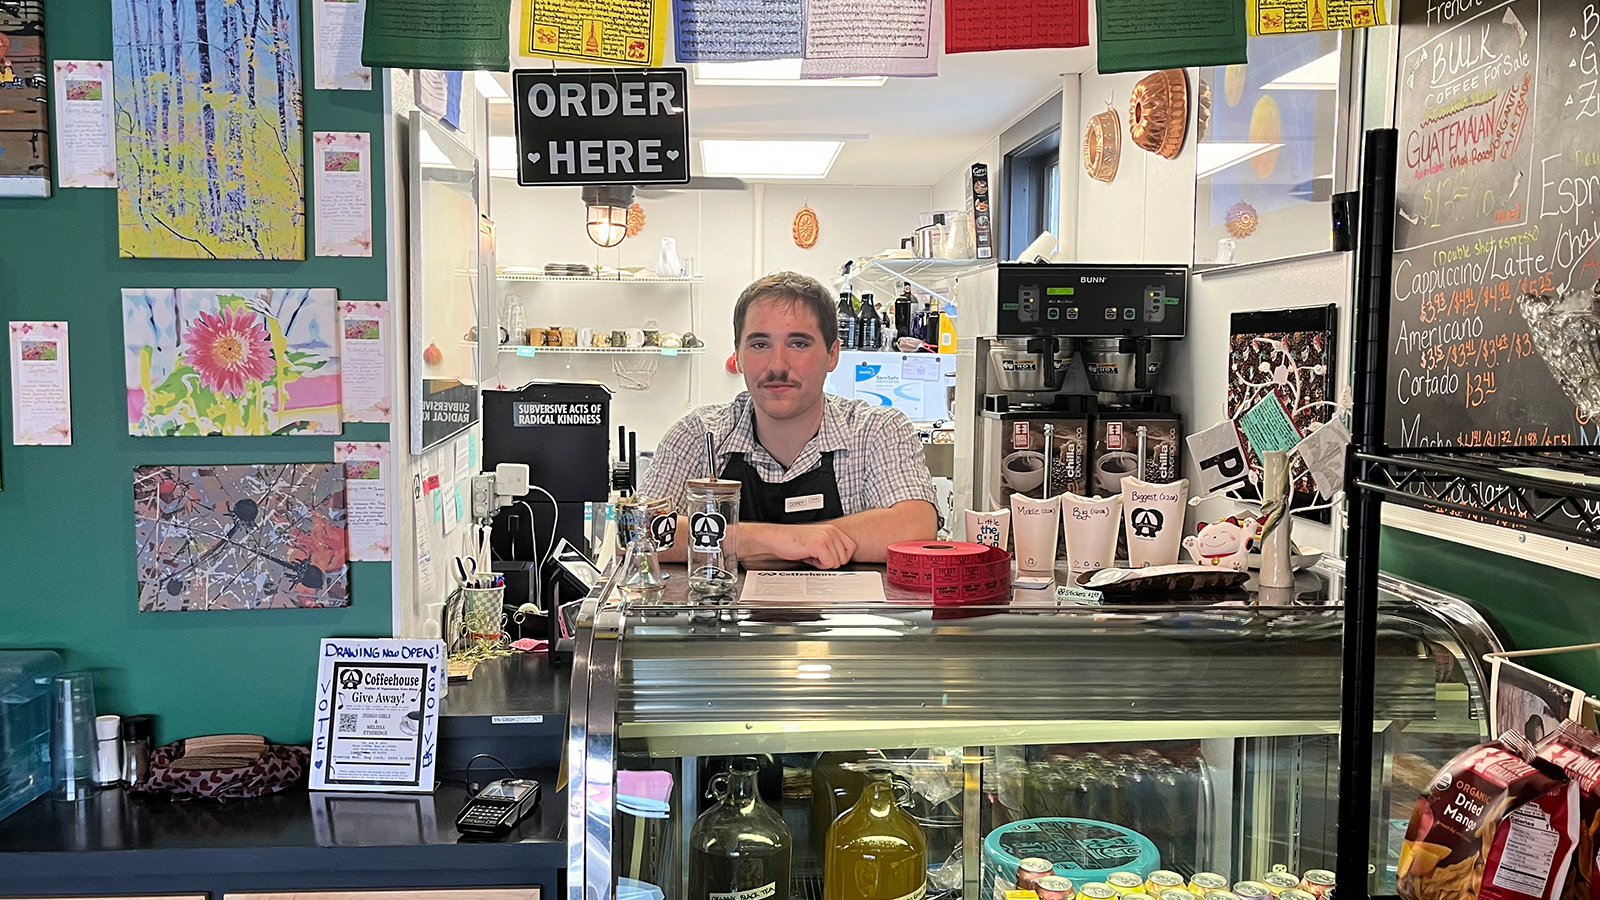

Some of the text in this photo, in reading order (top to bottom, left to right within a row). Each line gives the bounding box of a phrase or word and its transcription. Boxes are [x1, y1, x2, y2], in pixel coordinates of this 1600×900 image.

[1430, 23, 1496, 85] BULK
[1424, 75, 1479, 110] COFFEE
[1502, 51, 1530, 76] Sale
[527, 82, 676, 118] ORDER
[1494, 84, 1519, 149] ORGANIC
[1406, 101, 1496, 170] GUATEMALAN
[548, 139, 663, 174] HERE
[1432, 225, 1540, 268] (Double shot espresso)
[1080, 276, 1104, 284] BUNN
[1395, 316, 1484, 355] Americano
[1397, 367, 1459, 405] Cortado
[519, 404, 602, 414] SUBVERSIVE ACTS OF
[519, 414, 602, 425] RADICAL KINDNESS
[1131, 490, 1159, 503] Biggest
[977, 517, 999, 526] Little
[1017, 506, 1040, 515] Middle
[1072, 506, 1090, 520] Big
[980, 525, 997, 534] the
[365, 672, 420, 686] Coffeehouse
[352, 691, 405, 706] Give Away!
[1454, 792, 1485, 817] Dried
[1456, 780, 1492, 805] ORGANIC
[1443, 803, 1477, 832] Mango
[762, 886, 776, 896] TEA
